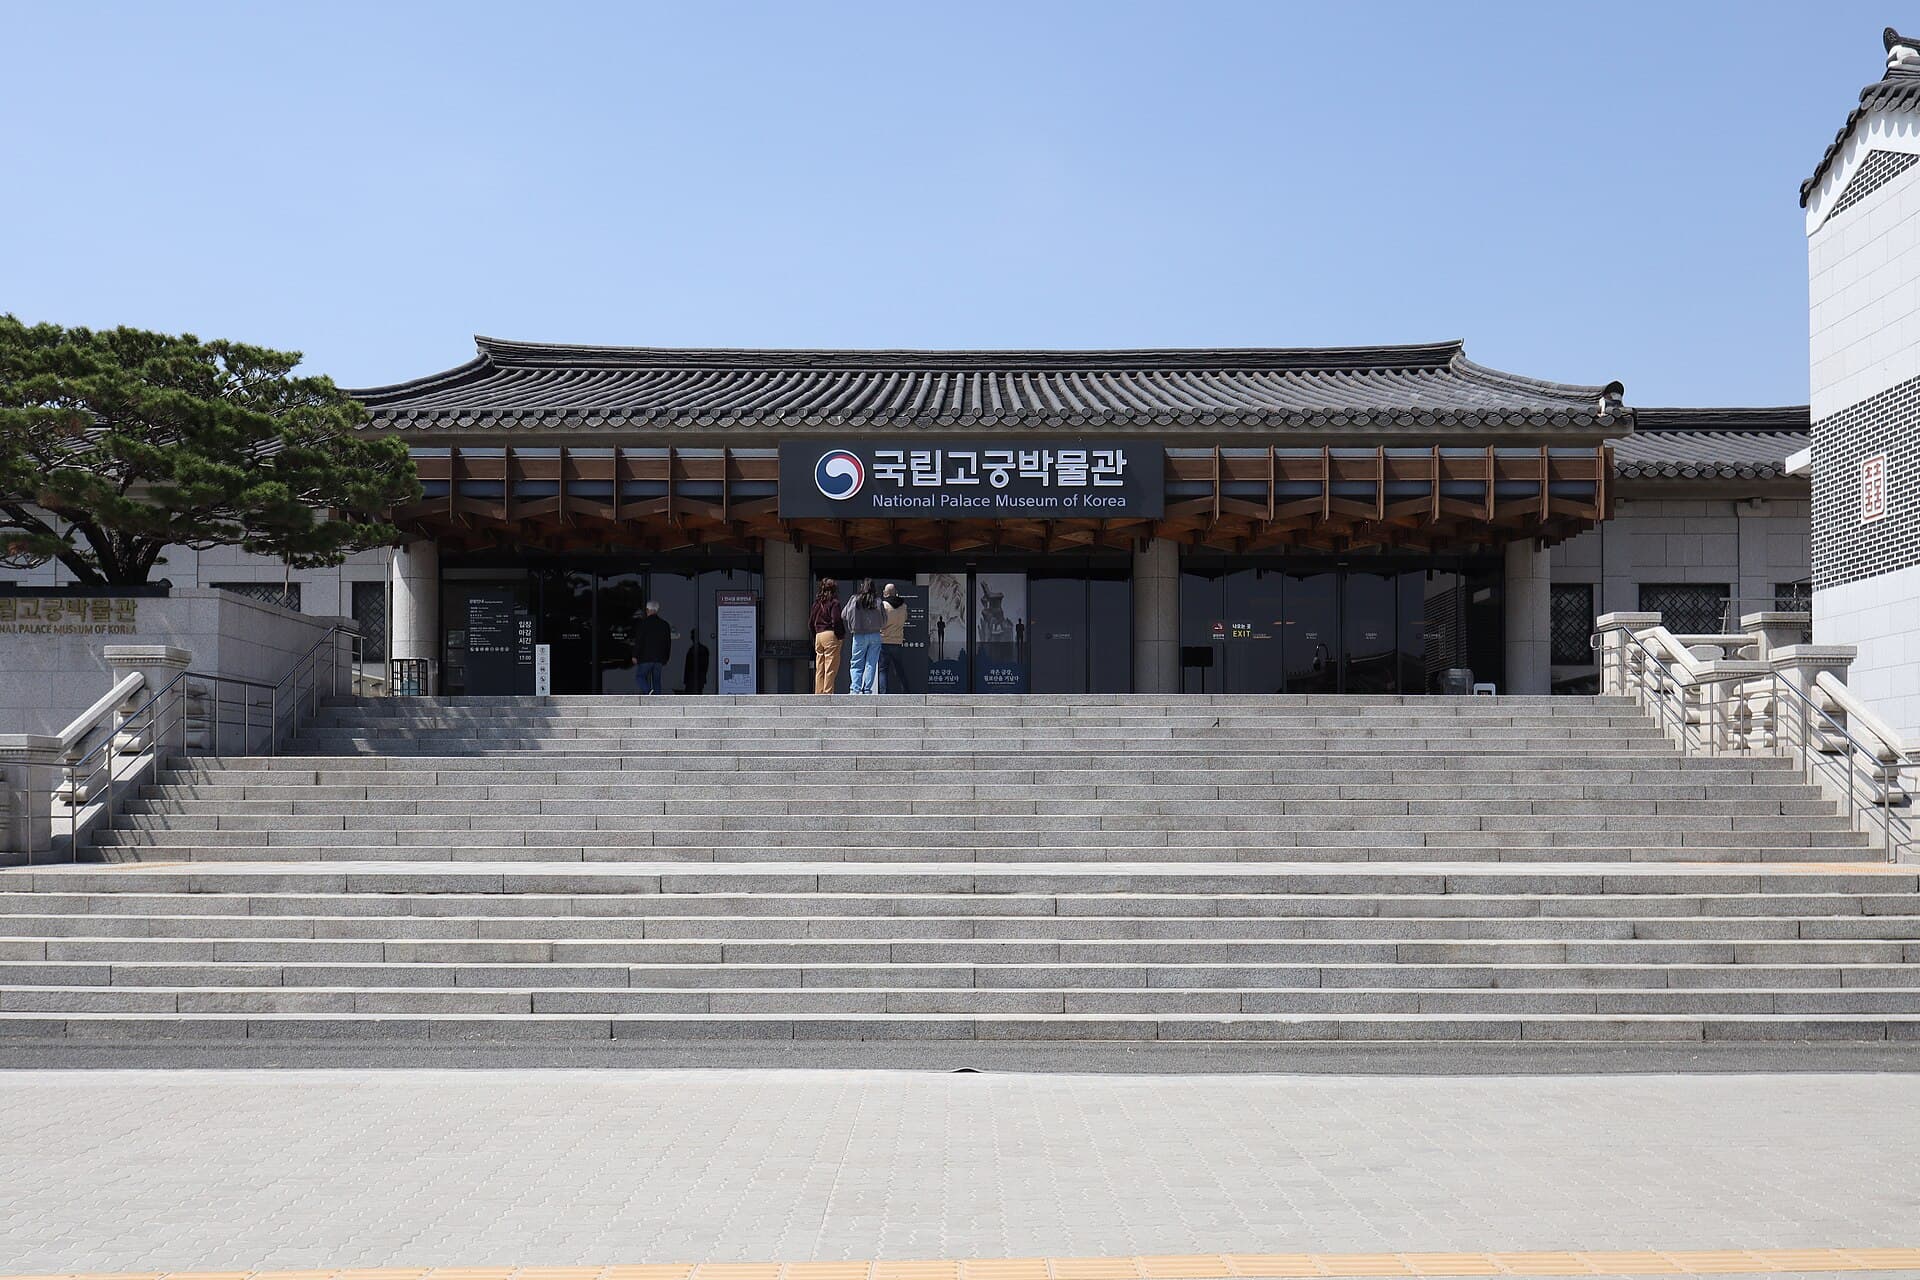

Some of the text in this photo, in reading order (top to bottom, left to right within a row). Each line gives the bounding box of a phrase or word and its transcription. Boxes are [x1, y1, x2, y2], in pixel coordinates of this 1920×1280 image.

[872, 449, 1127, 489] 국립고궁박물관
[873, 494, 1126, 508] National Palace Museum of Korea
[19, 624, 51, 634] PALACE
[54, 624, 93, 634] MUSEUM
[95, 624, 107, 634] OF
[109, 624, 137, 634] KOREA
[518, 621, 532, 629] 입장
[518, 629, 532, 637] 마감
[1232, 630, 1252, 638] EXIT
[518, 637, 532, 645] 시간
